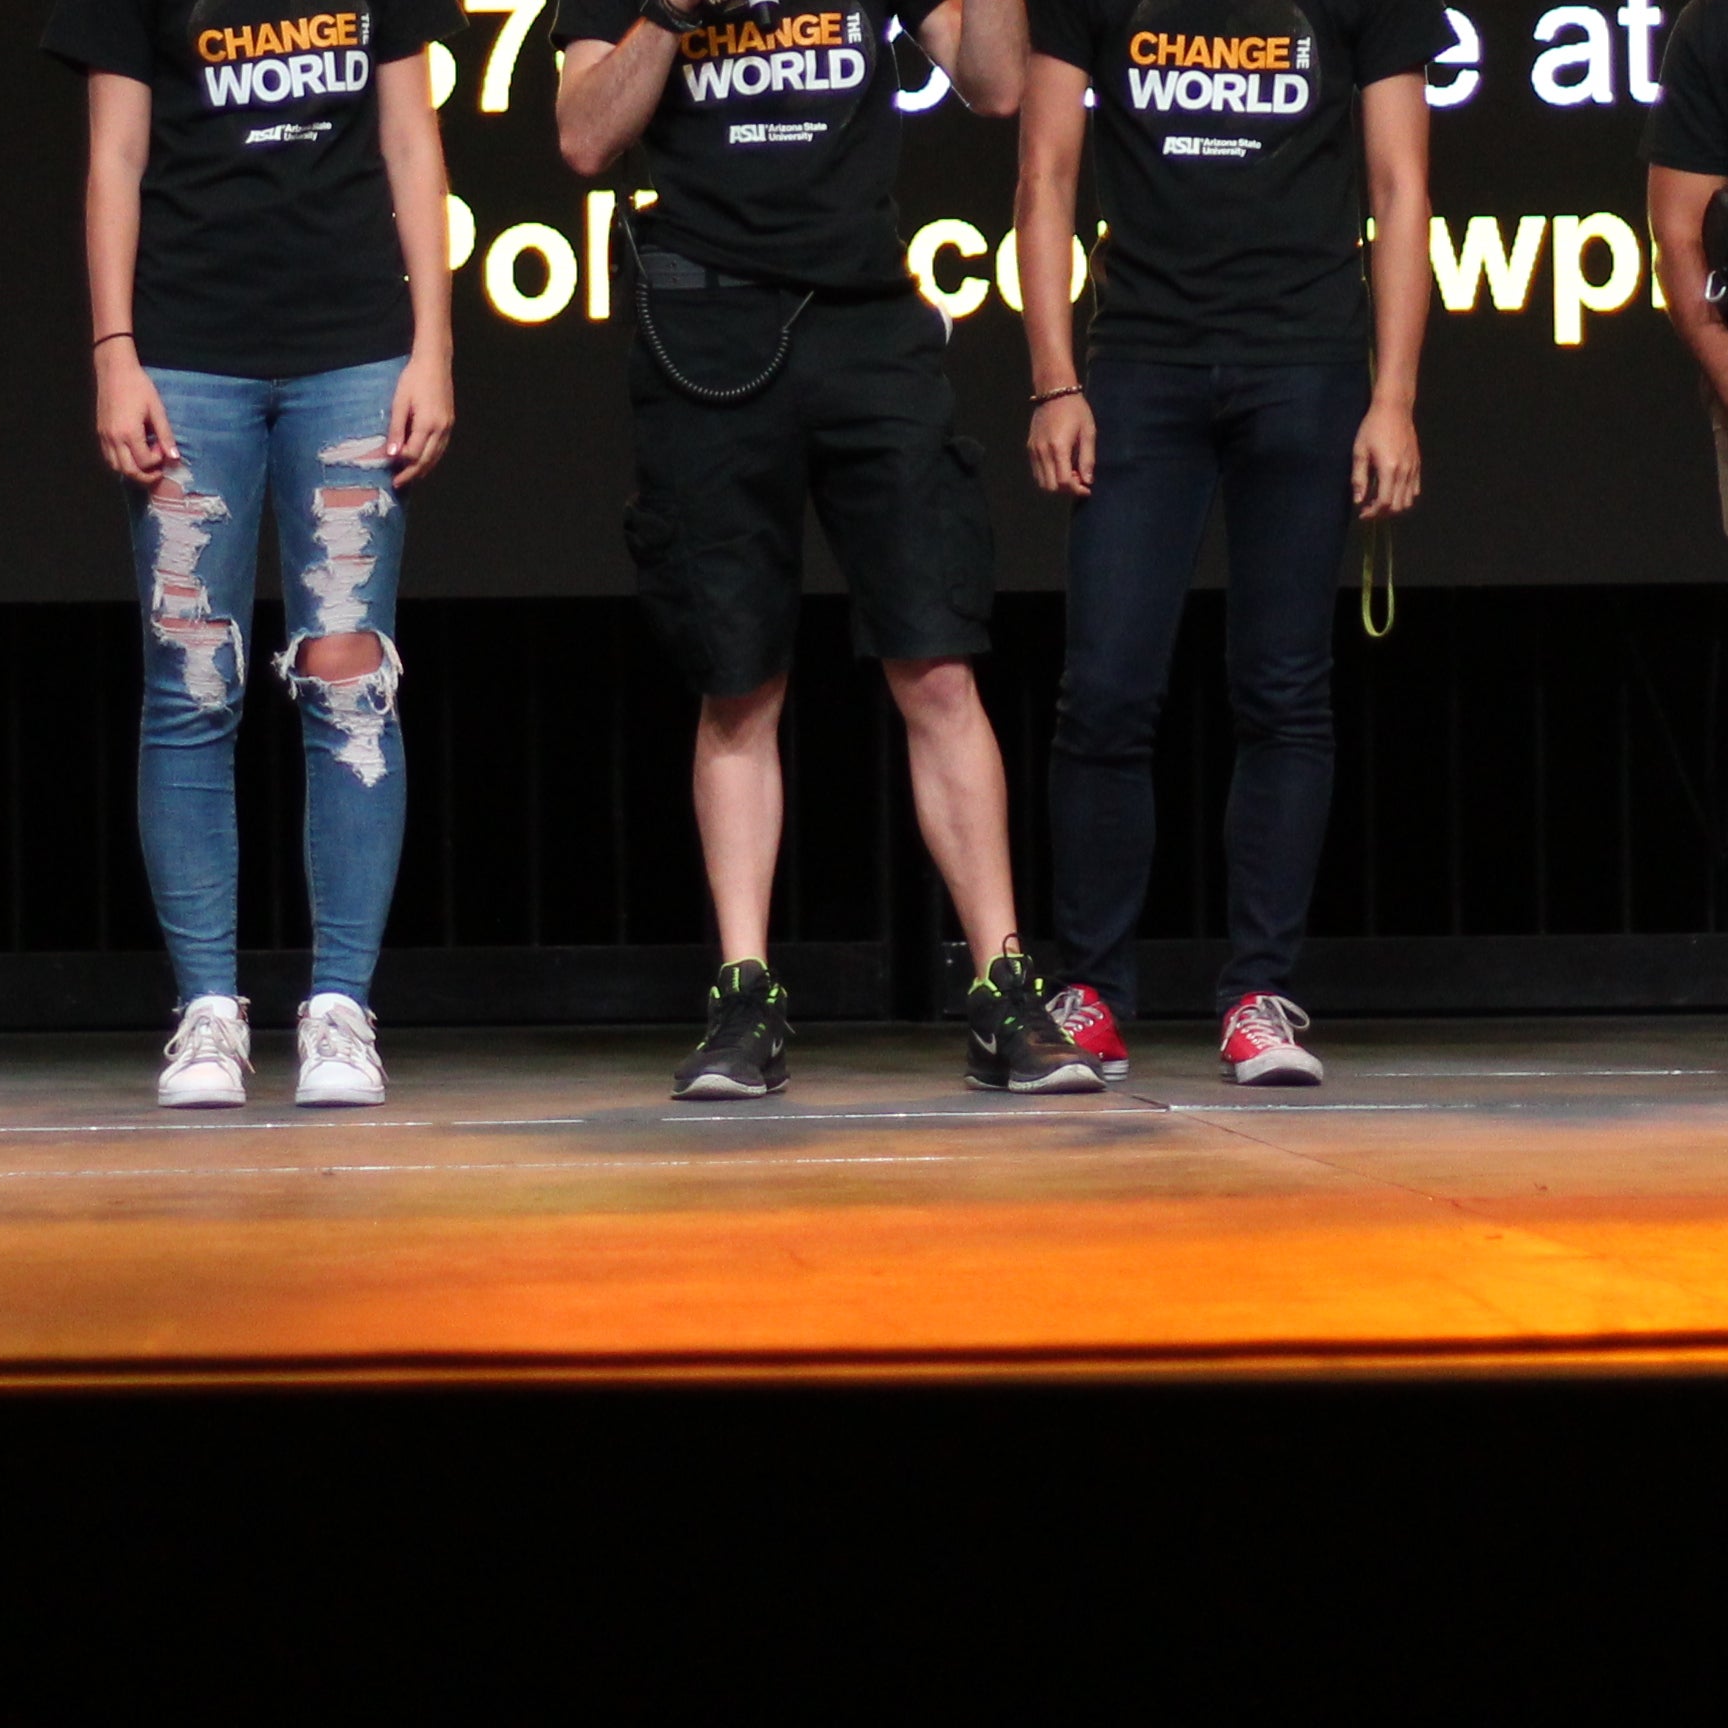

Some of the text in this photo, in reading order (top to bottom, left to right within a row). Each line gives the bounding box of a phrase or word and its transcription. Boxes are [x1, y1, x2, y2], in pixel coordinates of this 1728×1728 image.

[197, 13, 358, 62] CHANGE
[680, 13, 842, 59] CHANGE
[846, 12, 861, 44] THE
[1129, 31, 1291, 70] CHANGE
[1296, 36, 1311, 70] THE
[204, 50, 369, 107] WORLD
[682, 48, 866, 103] WORLD
[1128, 68, 1310, 114] WORLD
[729, 123, 766, 144] ASU
[1162, 136, 1201, 155] ASU
